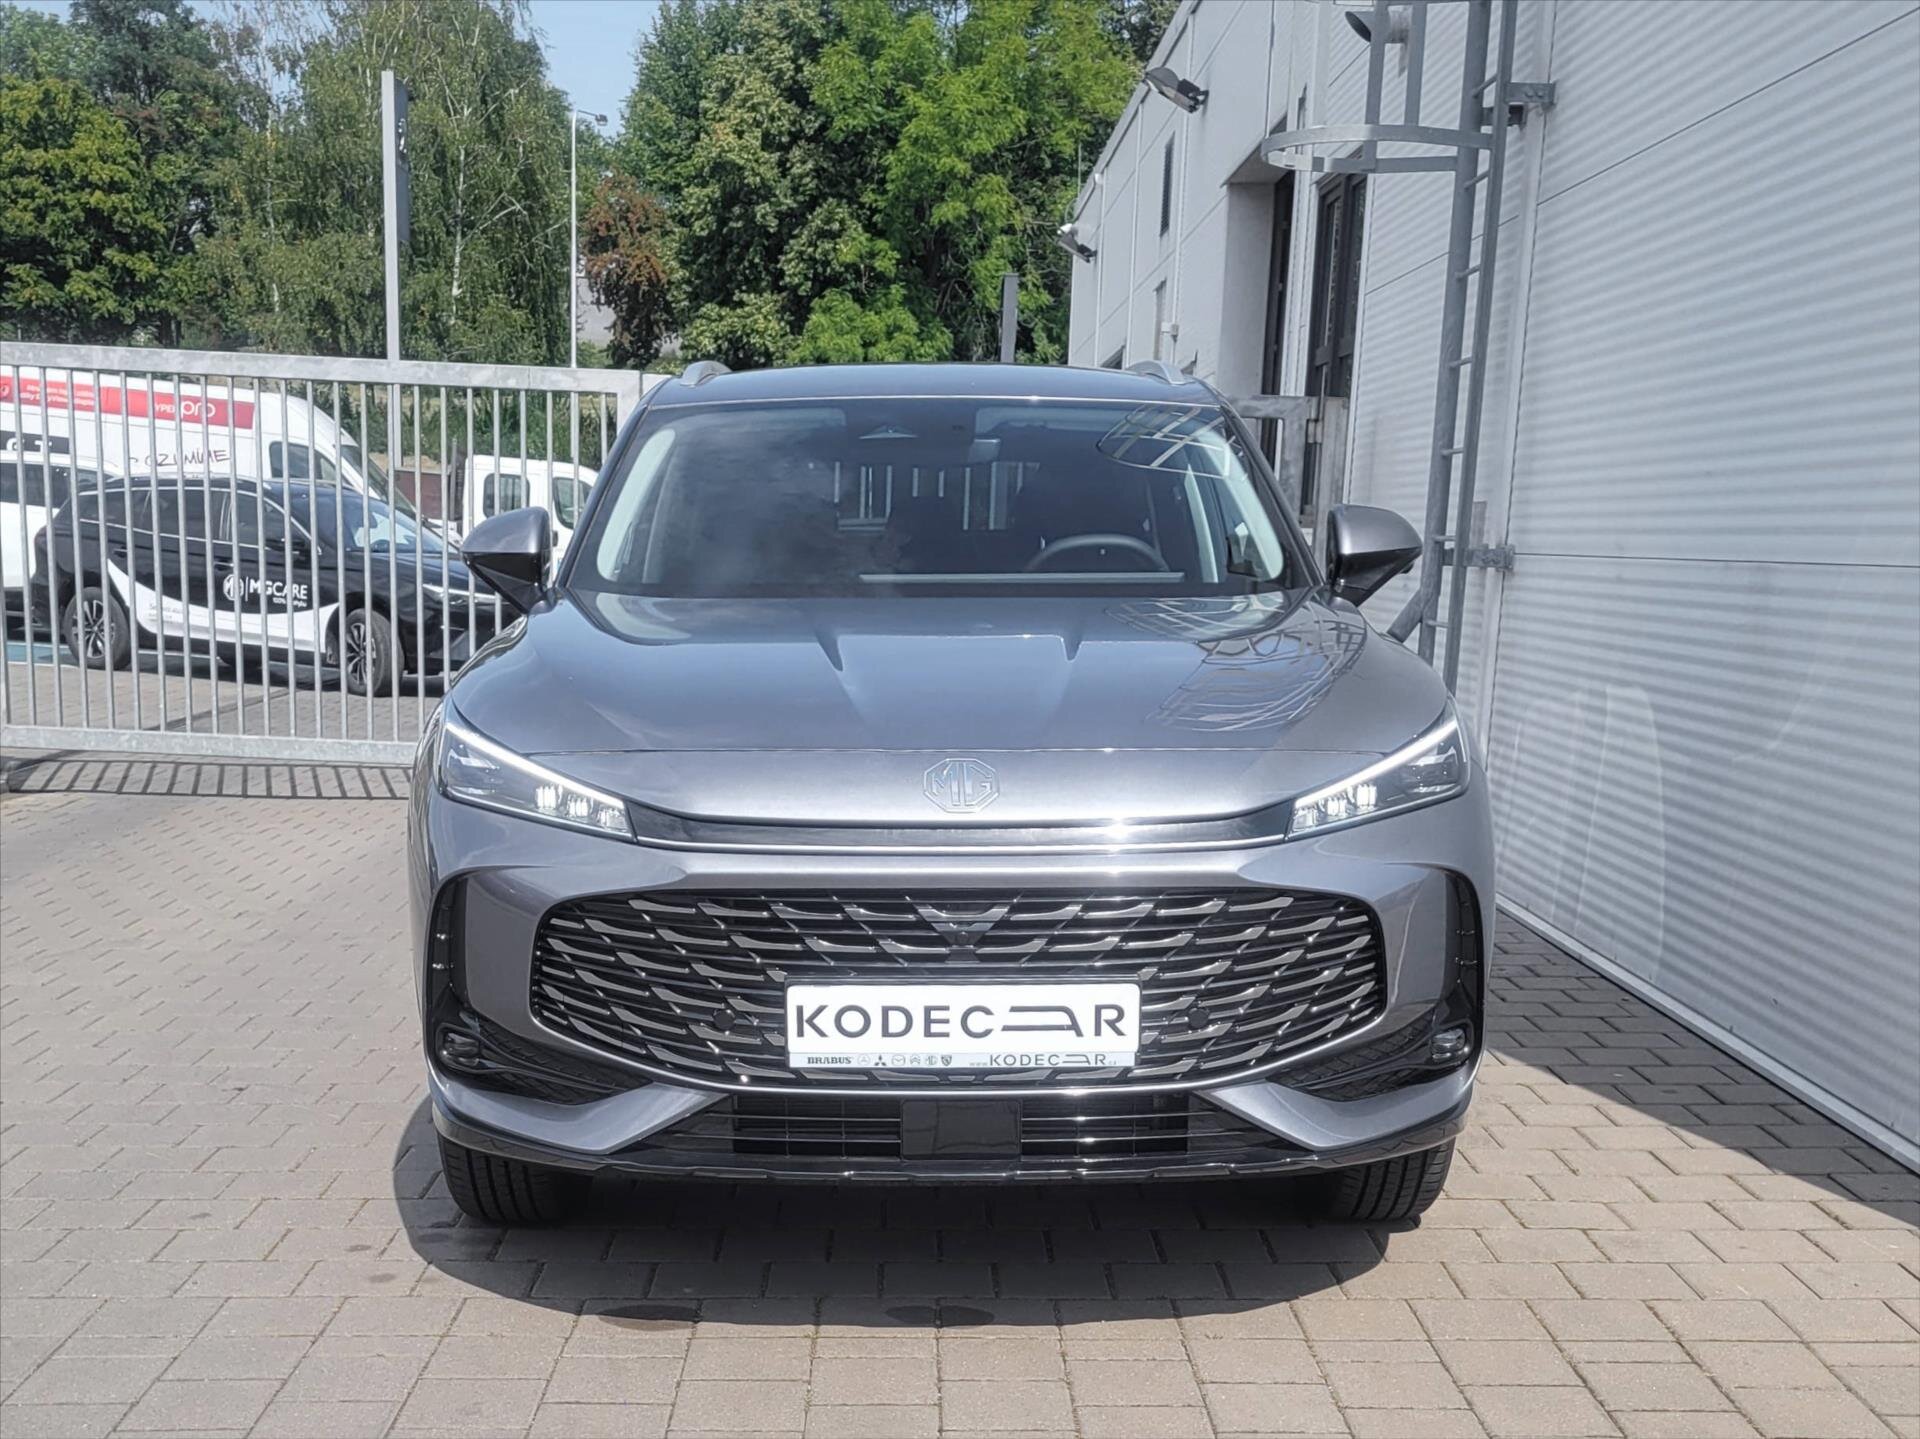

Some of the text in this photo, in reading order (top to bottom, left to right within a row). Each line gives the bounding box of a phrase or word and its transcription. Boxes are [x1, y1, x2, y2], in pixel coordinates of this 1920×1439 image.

[927, 758, 997, 811] MG
[796, 1004, 1126, 1038] KODECAR
[807, 1056, 852, 1065] BRABUS
